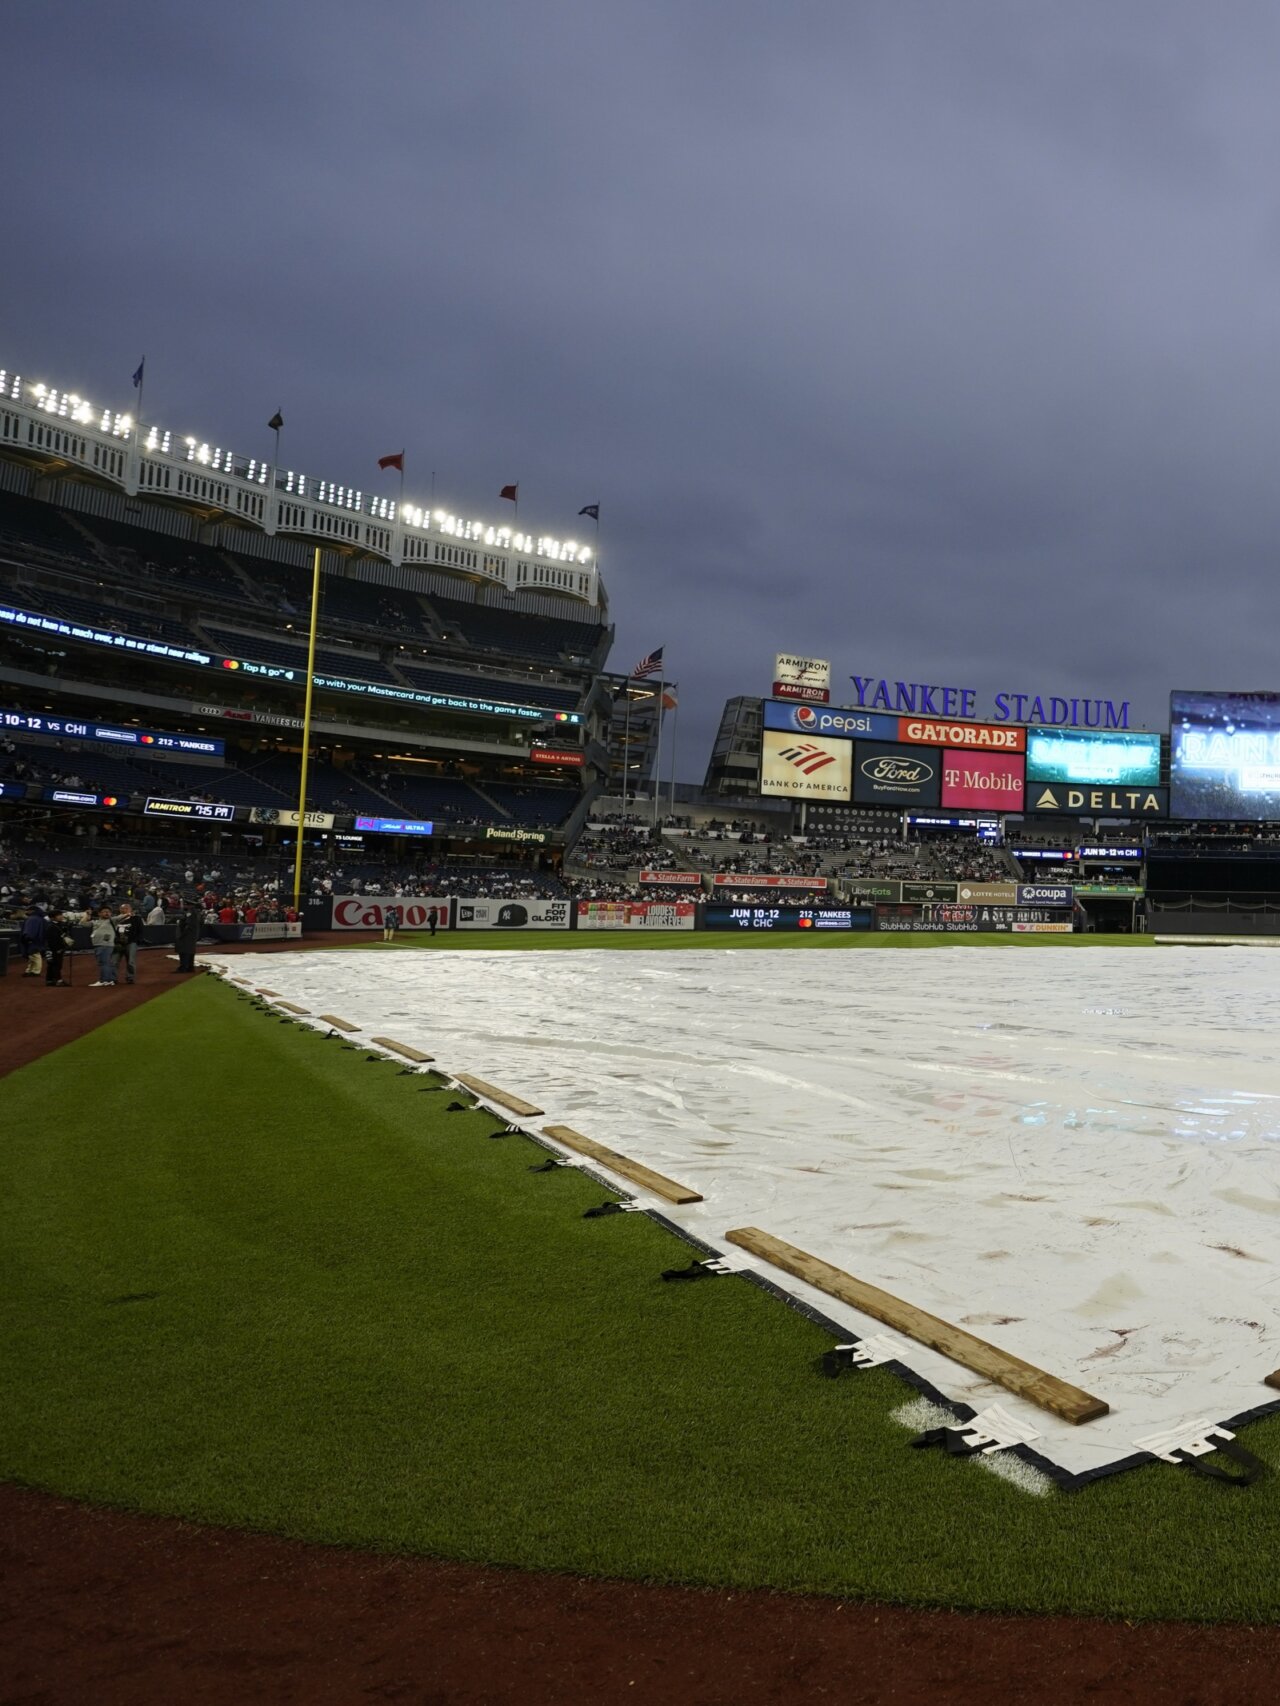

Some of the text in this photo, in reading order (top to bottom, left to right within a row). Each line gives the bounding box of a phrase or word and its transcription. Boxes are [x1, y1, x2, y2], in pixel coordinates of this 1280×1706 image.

[16, 612, 26, 622] do
[27, 617, 41, 626] not
[72, 628, 94, 639] reach
[242, 662, 267, 674] Tap &
[779, 658, 828, 671] ARMITRON
[780, 685, 824, 696] ARMITRON
[326, 679, 346, 688] with
[347, 684, 366, 692] your
[367, 685, 415, 700] Mastercard
[416, 694, 431, 702] and
[432, 697, 446, 705] get
[448, 698, 468, 708] back
[479, 703, 493, 711] the
[494, 706, 516, 714] game
[518, 708, 542, 718] faster.
[850, 675, 1130, 729] YANKEE STADIUM
[255, 714, 290, 726] YANKEES
[820, 714, 870, 732] pepsi
[6, 714, 41, 729] 10-12
[65, 723, 87, 735] CHI
[158, 738, 172, 746] 212
[180, 740, 215, 752] YANKEES
[907, 723, 1017, 747] GATORADE
[1184, 735, 1266, 762] RAIN
[874, 761, 919, 781] Ford
[763, 780, 790, 788] BANK
[806, 783, 849, 793] AMERICA
[963, 770, 1022, 792] Mobile
[873, 784, 920, 793] BuyFordNow.com
[1068, 791, 1159, 810] DELTA
[149, 803, 229, 817] ARMITRON 7:15 PM
[486, 828, 545, 842] Poland Spring
[1083, 848, 1098, 856] JUN
[852, 887, 871, 895] Uber
[1036, 889, 1066, 899] coupa
[334, 900, 448, 926] Canon
[647, 905, 677, 915] LOUDEST
[730, 909, 779, 918] JUN 10-12
[753, 919, 773, 927] CHC
[880, 922, 910, 930] StubHub
